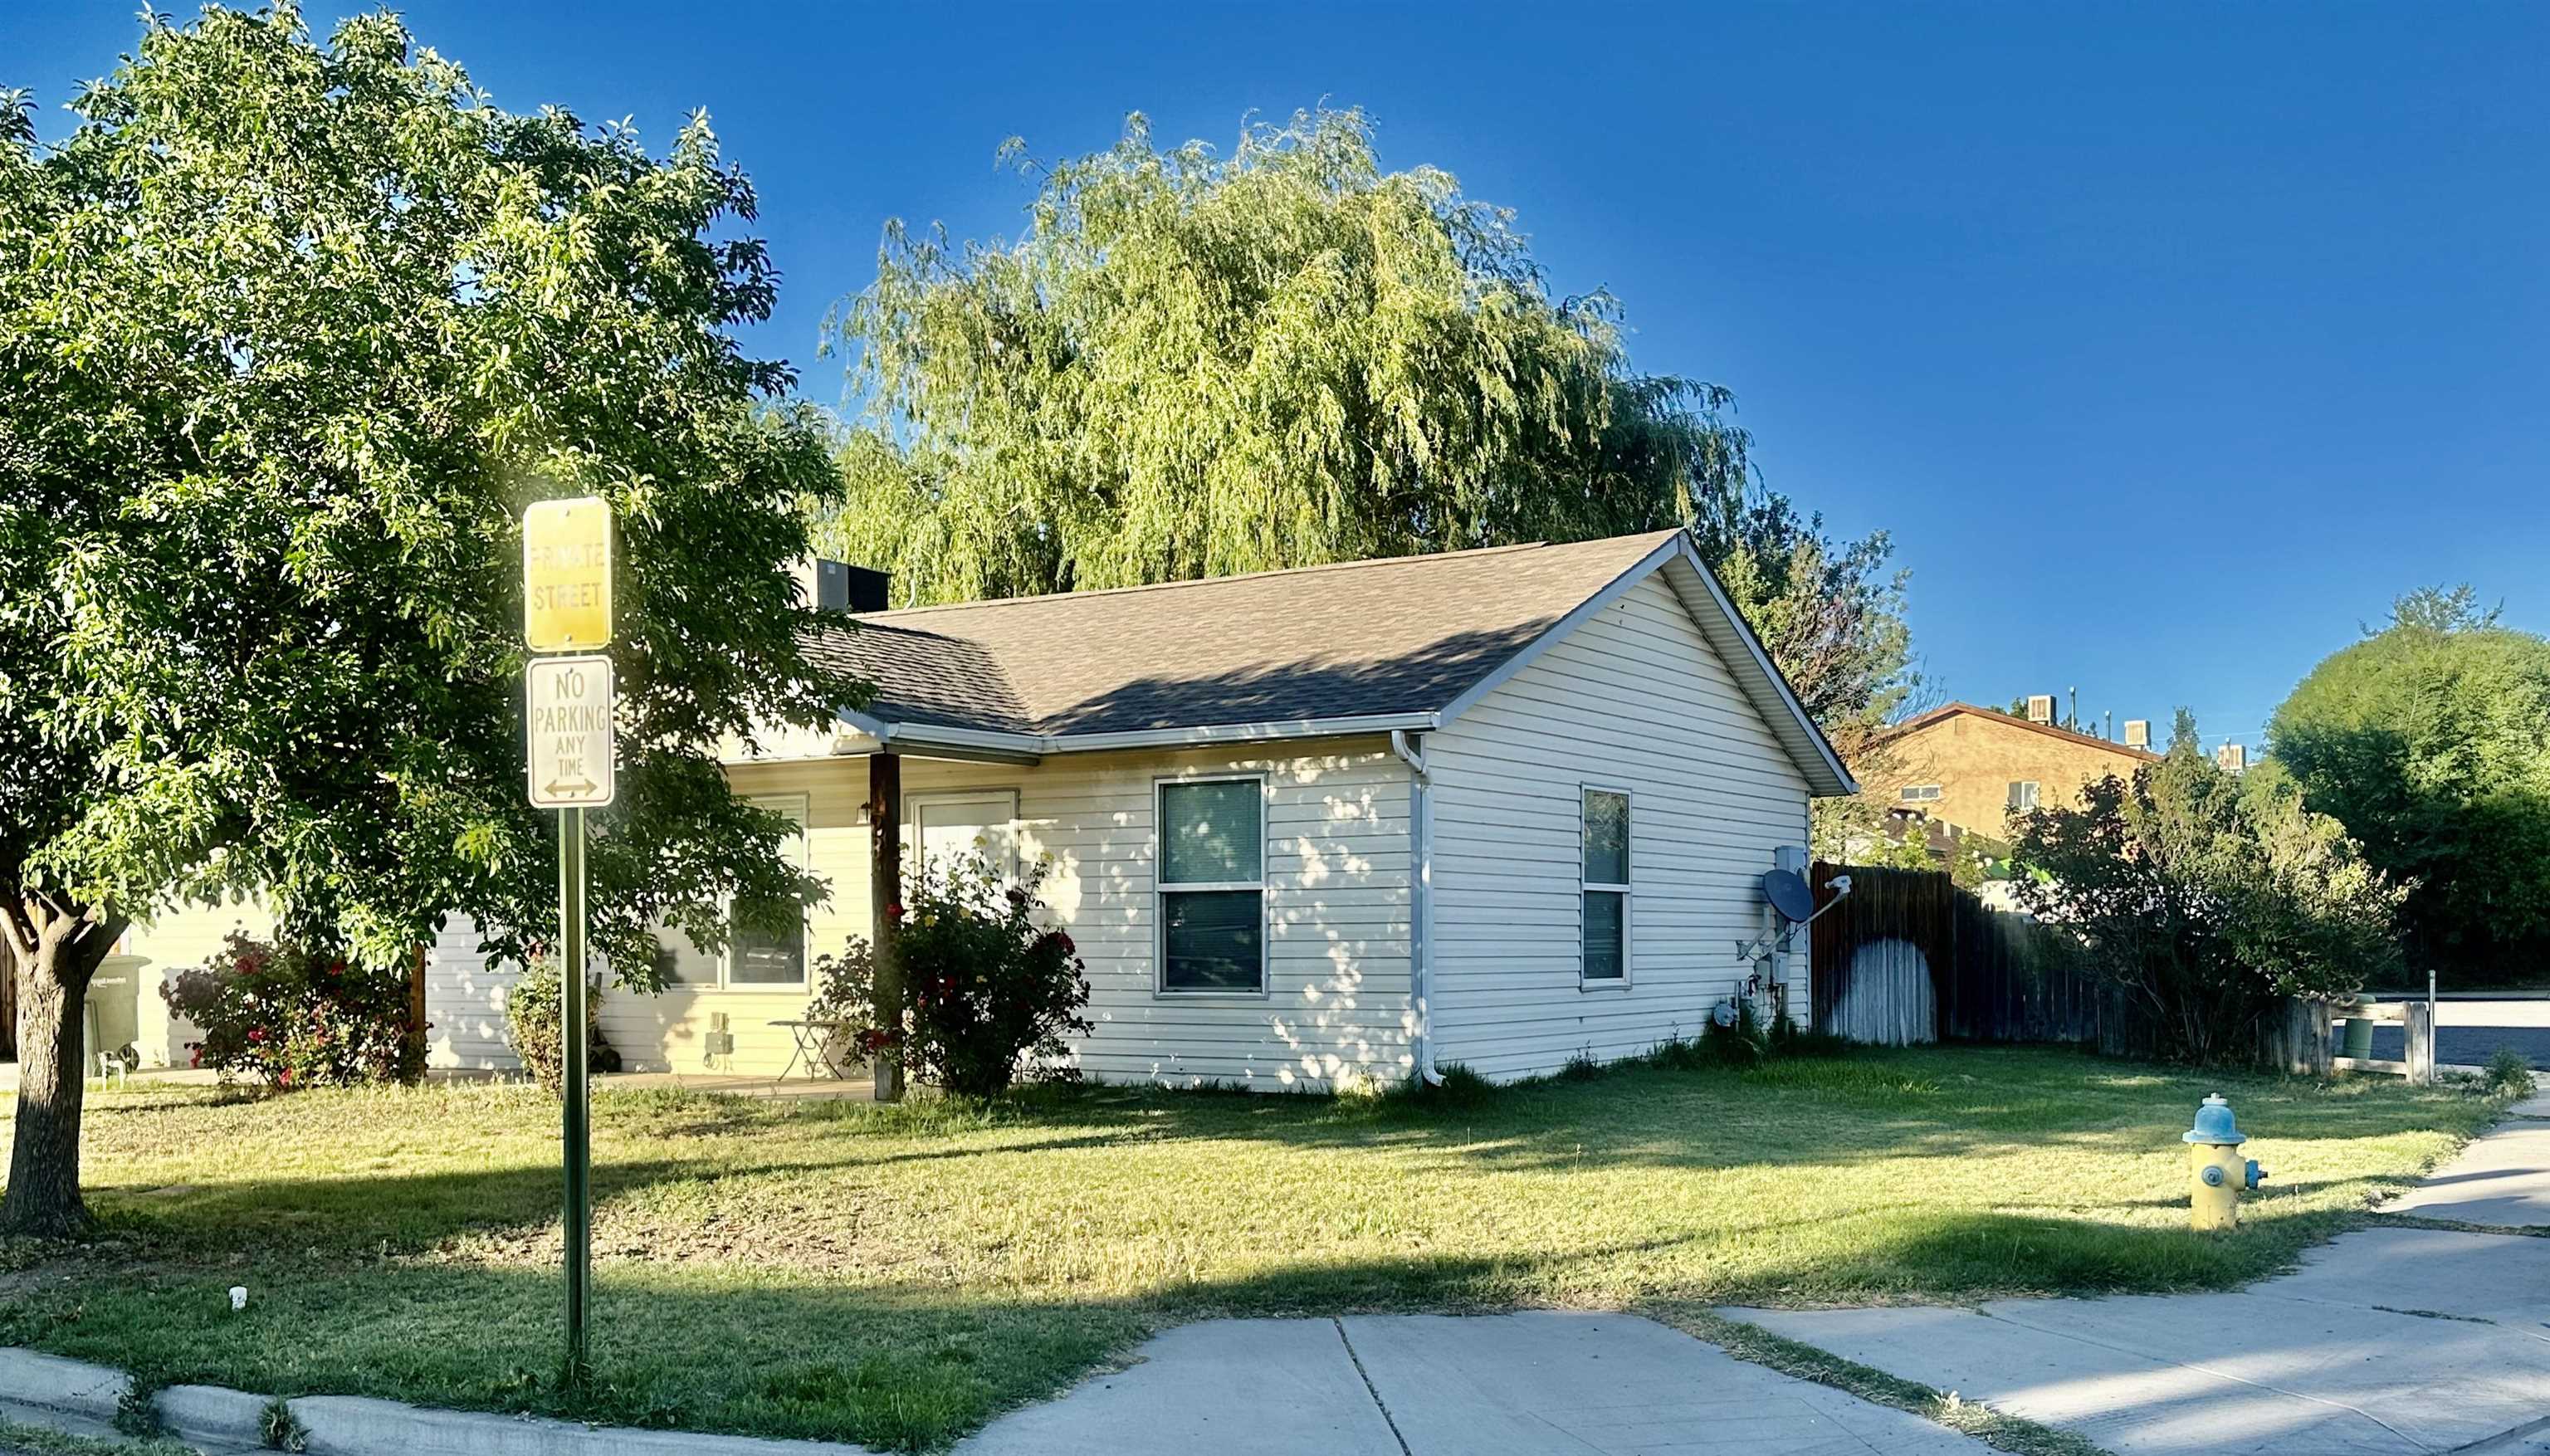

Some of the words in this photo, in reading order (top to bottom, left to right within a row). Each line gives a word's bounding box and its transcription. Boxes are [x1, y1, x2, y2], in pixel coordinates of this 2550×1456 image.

[534, 583, 602, 610] STREET
[555, 672, 584, 700] NO
[535, 706, 606, 733] PARKING
[555, 735, 585, 755] ANY
[558, 759, 584, 777] TIME
